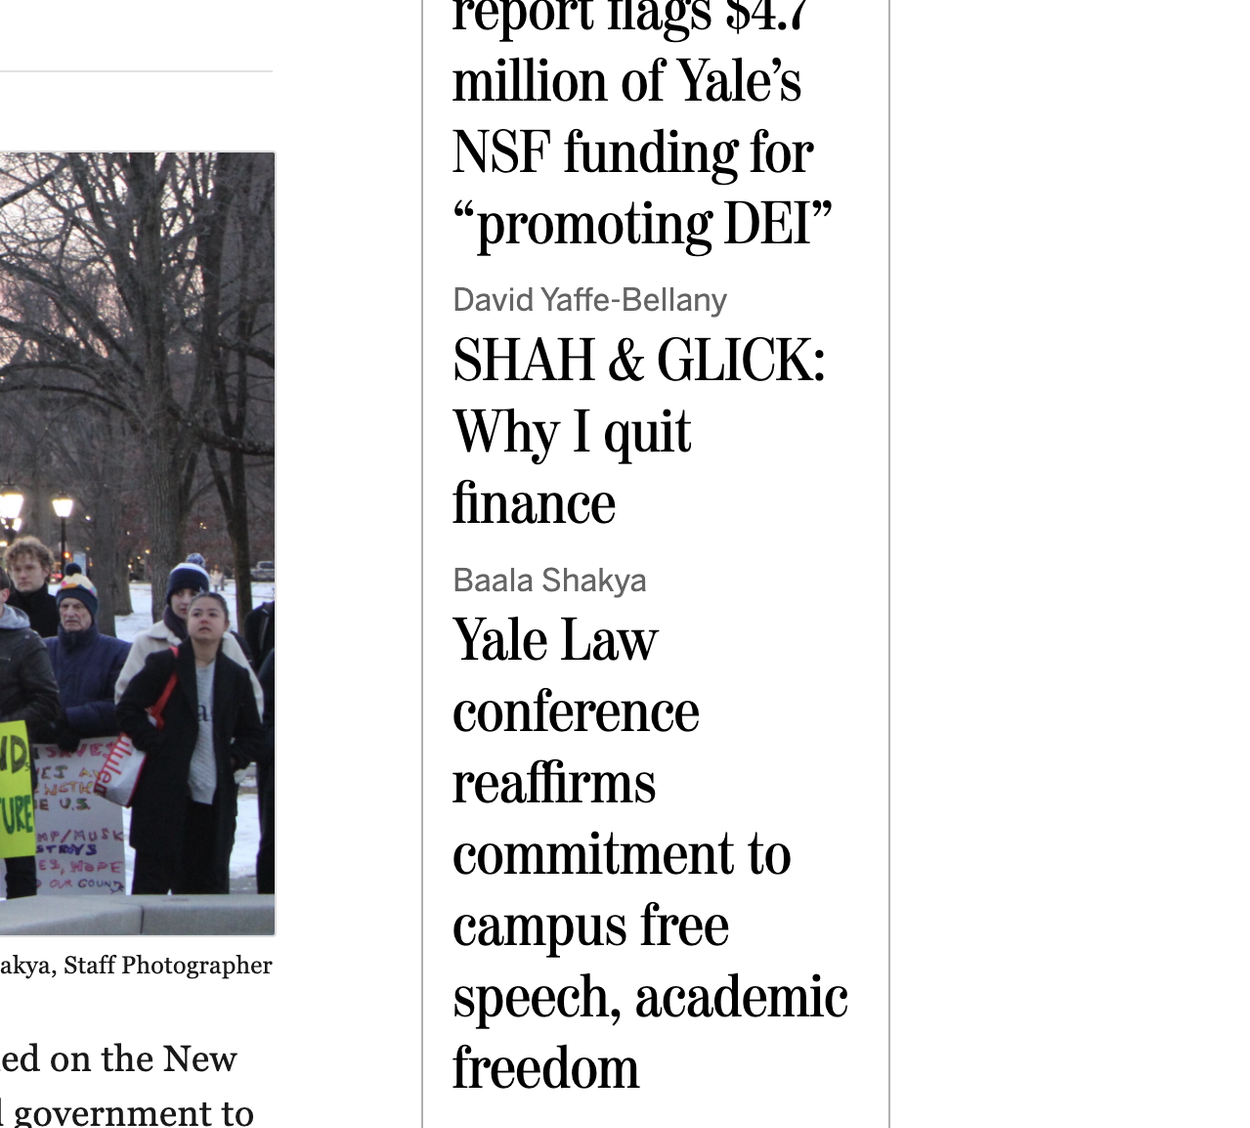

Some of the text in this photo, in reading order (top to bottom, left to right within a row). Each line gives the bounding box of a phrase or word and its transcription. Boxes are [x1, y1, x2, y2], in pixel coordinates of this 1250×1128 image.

[452, 57, 608, 102] million
[622, 57, 667, 102] of
[452, 129, 814, 185] NSF funding for
[455, 287, 727, 317] David Yaffe-Bellany
[455, 337, 824, 381] SHAH & GLICK:
[452, 408, 691, 465] Why I quit
[452, 480, 615, 524] finance
[455, 567, 646, 598] Baala Shakya
[452, 616, 659, 661] Yale Law
[453, 688, 699, 732] conference
[452, 759, 655, 803] reaffirms
[453, 831, 791, 875] commitment to
[453, 902, 729, 958] campus free
[64, 955, 117, 974] Staff
[122, 955, 273, 979] Photographer
[454, 973, 848, 1029] speech, academic
[51, 1052, 91, 1072] on
[101, 1043, 153, 1072] the
[163, 1045, 238, 1072] New
[452, 1044, 640, 1089] freedom
